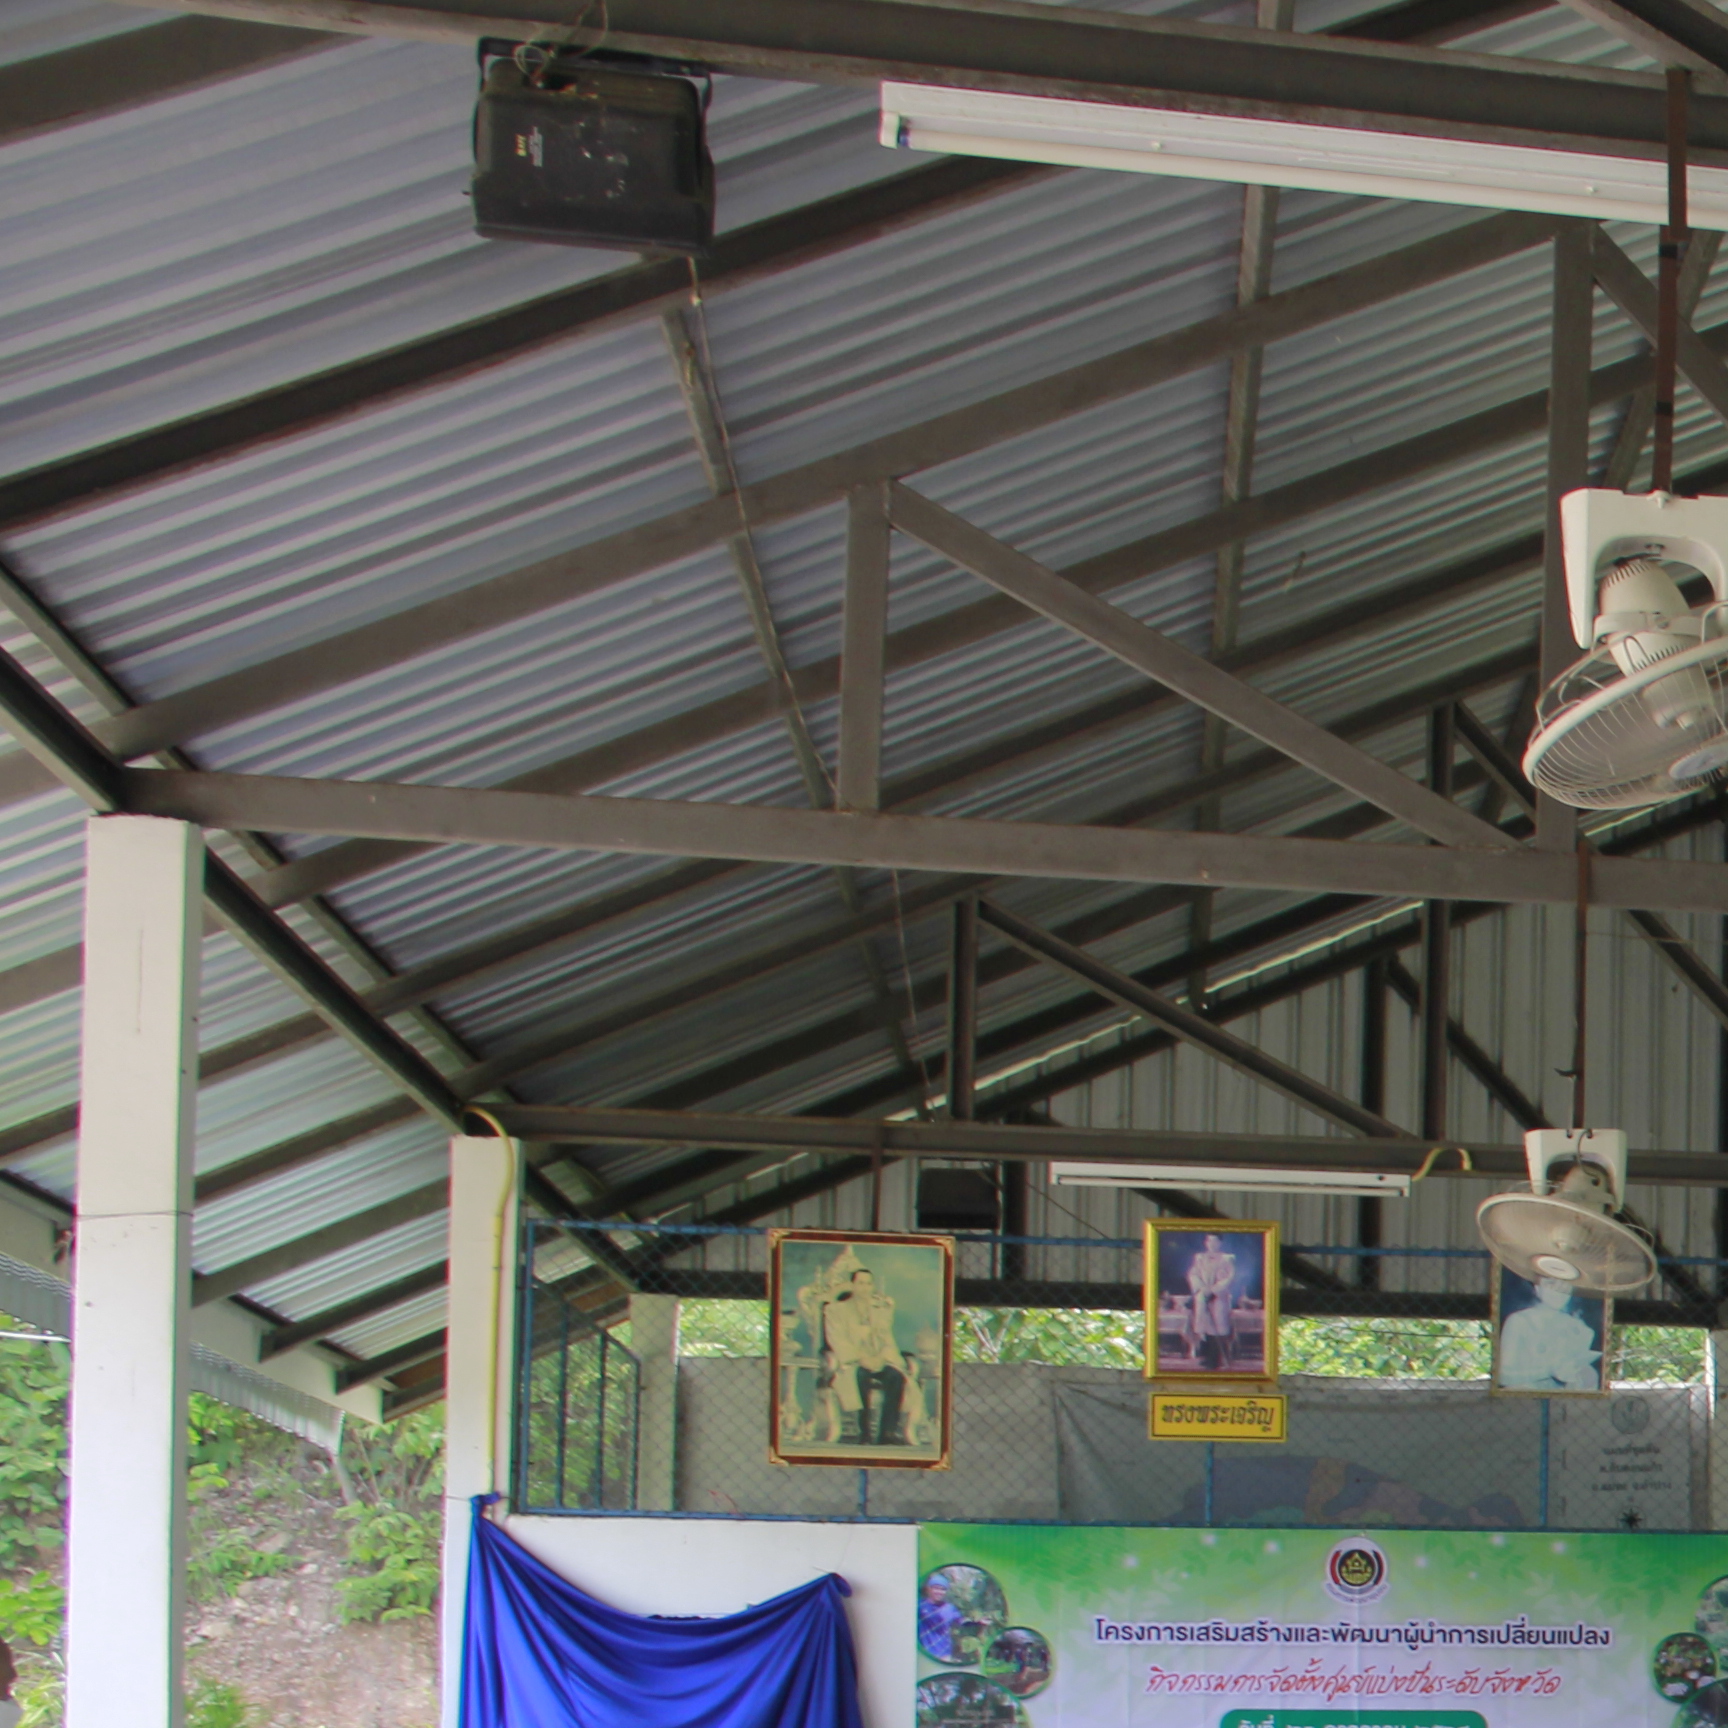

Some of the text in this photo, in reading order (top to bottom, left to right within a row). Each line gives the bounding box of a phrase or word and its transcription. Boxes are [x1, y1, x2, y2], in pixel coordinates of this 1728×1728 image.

[1162, 1401, 1274, 1432] ทรงพระเจริญ
[1094, 1617, 1609, 1651] โครงการเสริมสร้างและพัฒนาผู้นำการเปลี่ยนแปลง
